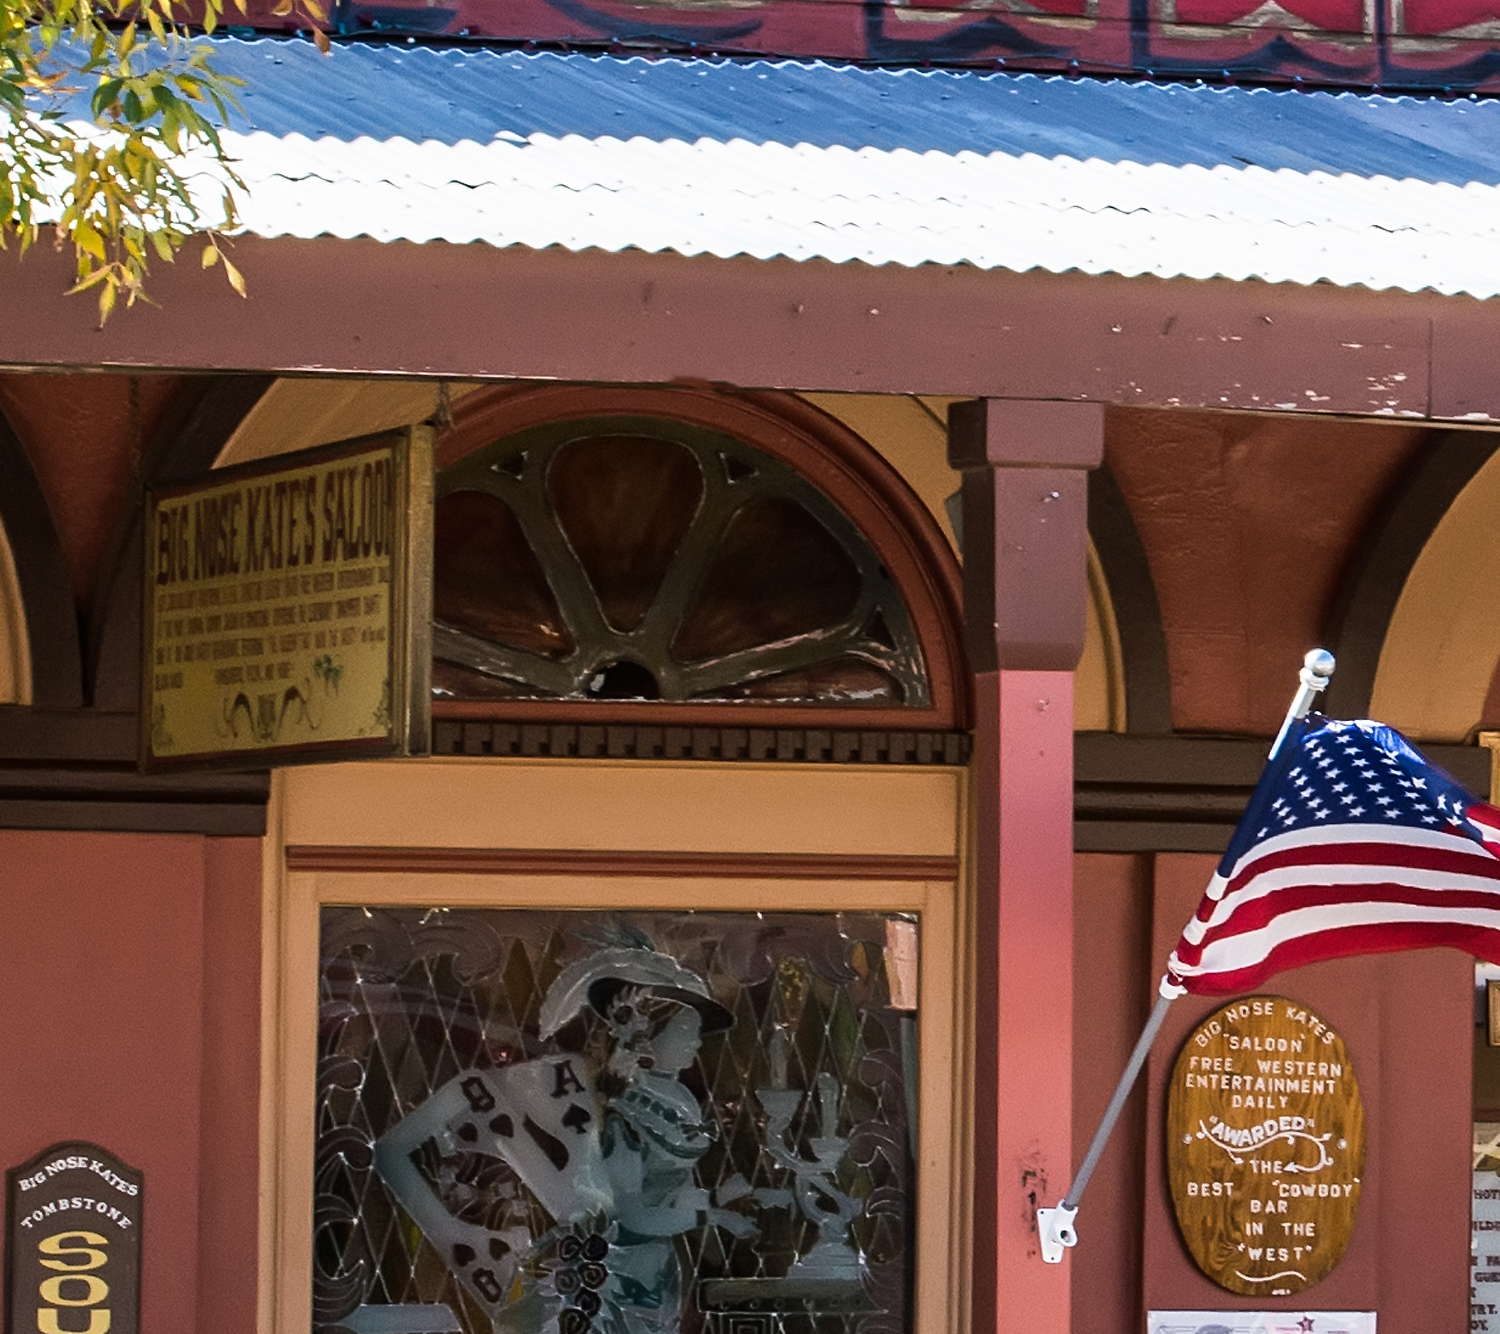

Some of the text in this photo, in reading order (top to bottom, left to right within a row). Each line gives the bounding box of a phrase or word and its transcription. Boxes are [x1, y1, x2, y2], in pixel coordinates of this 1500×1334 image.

[1195, 1002, 1336, 1047] BIG NOSE KATES
[1189, 1056, 1343, 1078] FREE WESTERN
[1185, 1073, 1336, 1096] ENTERTAINMENT
[1231, 1094, 1289, 1110] DAILY
[18, 1156, 139, 1197] BIG NOSE KATES
[1250, 1160, 1283, 1174] THE
[1187, 1182, 1235, 1197] BEST
[20, 1197, 133, 1231] TOMBSTONE
[1250, 1199, 1289, 1214] BAR
[1245, 1222, 1316, 1237] IN THE
